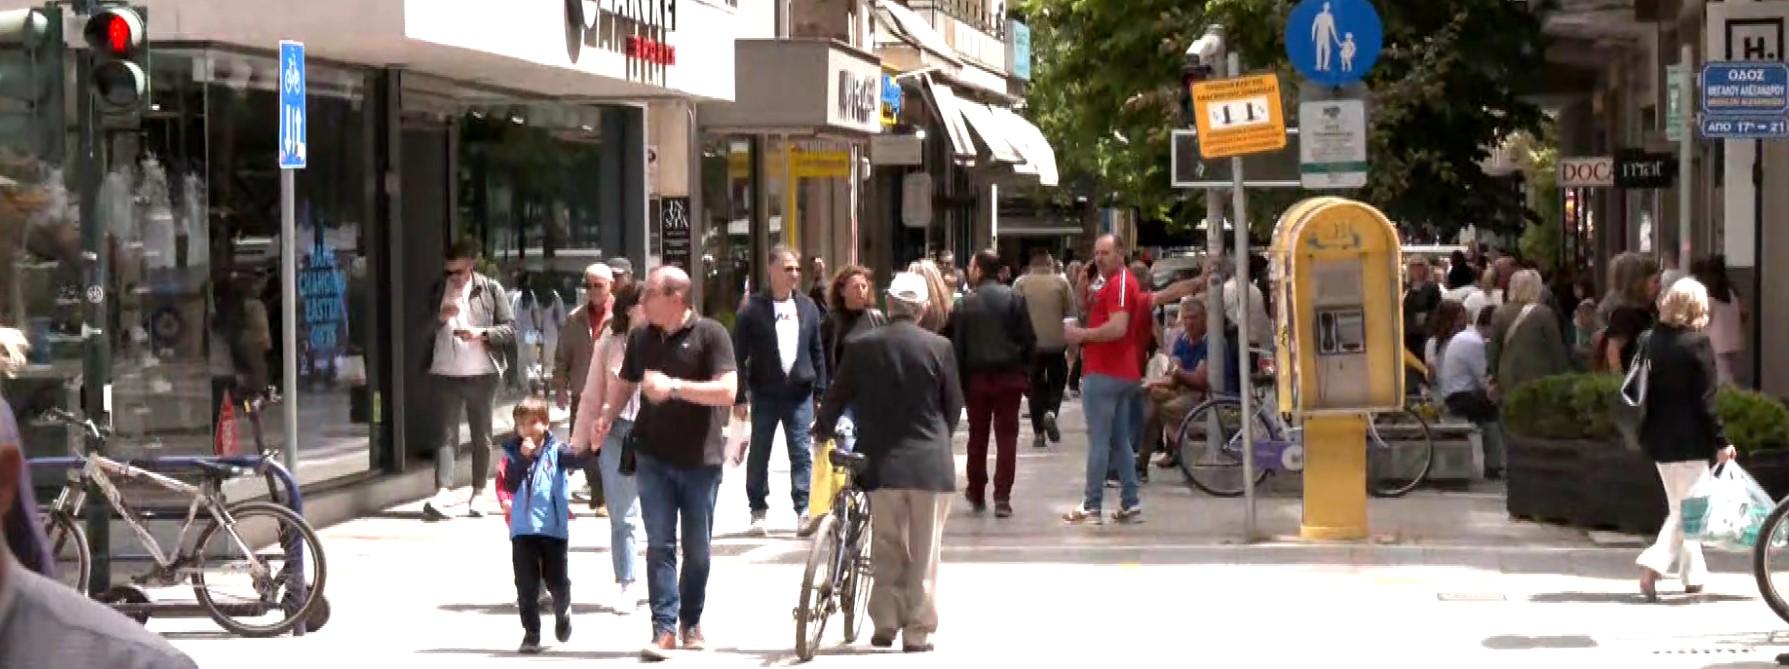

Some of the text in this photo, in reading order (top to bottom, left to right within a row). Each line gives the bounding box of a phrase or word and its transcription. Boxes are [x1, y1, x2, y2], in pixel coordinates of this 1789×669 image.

[1728, 69, 1765, 81] ΟΔΟΣ
[1708, 121, 1732, 132] ΑΠΟ
[305, 297, 341, 322] EASTER
